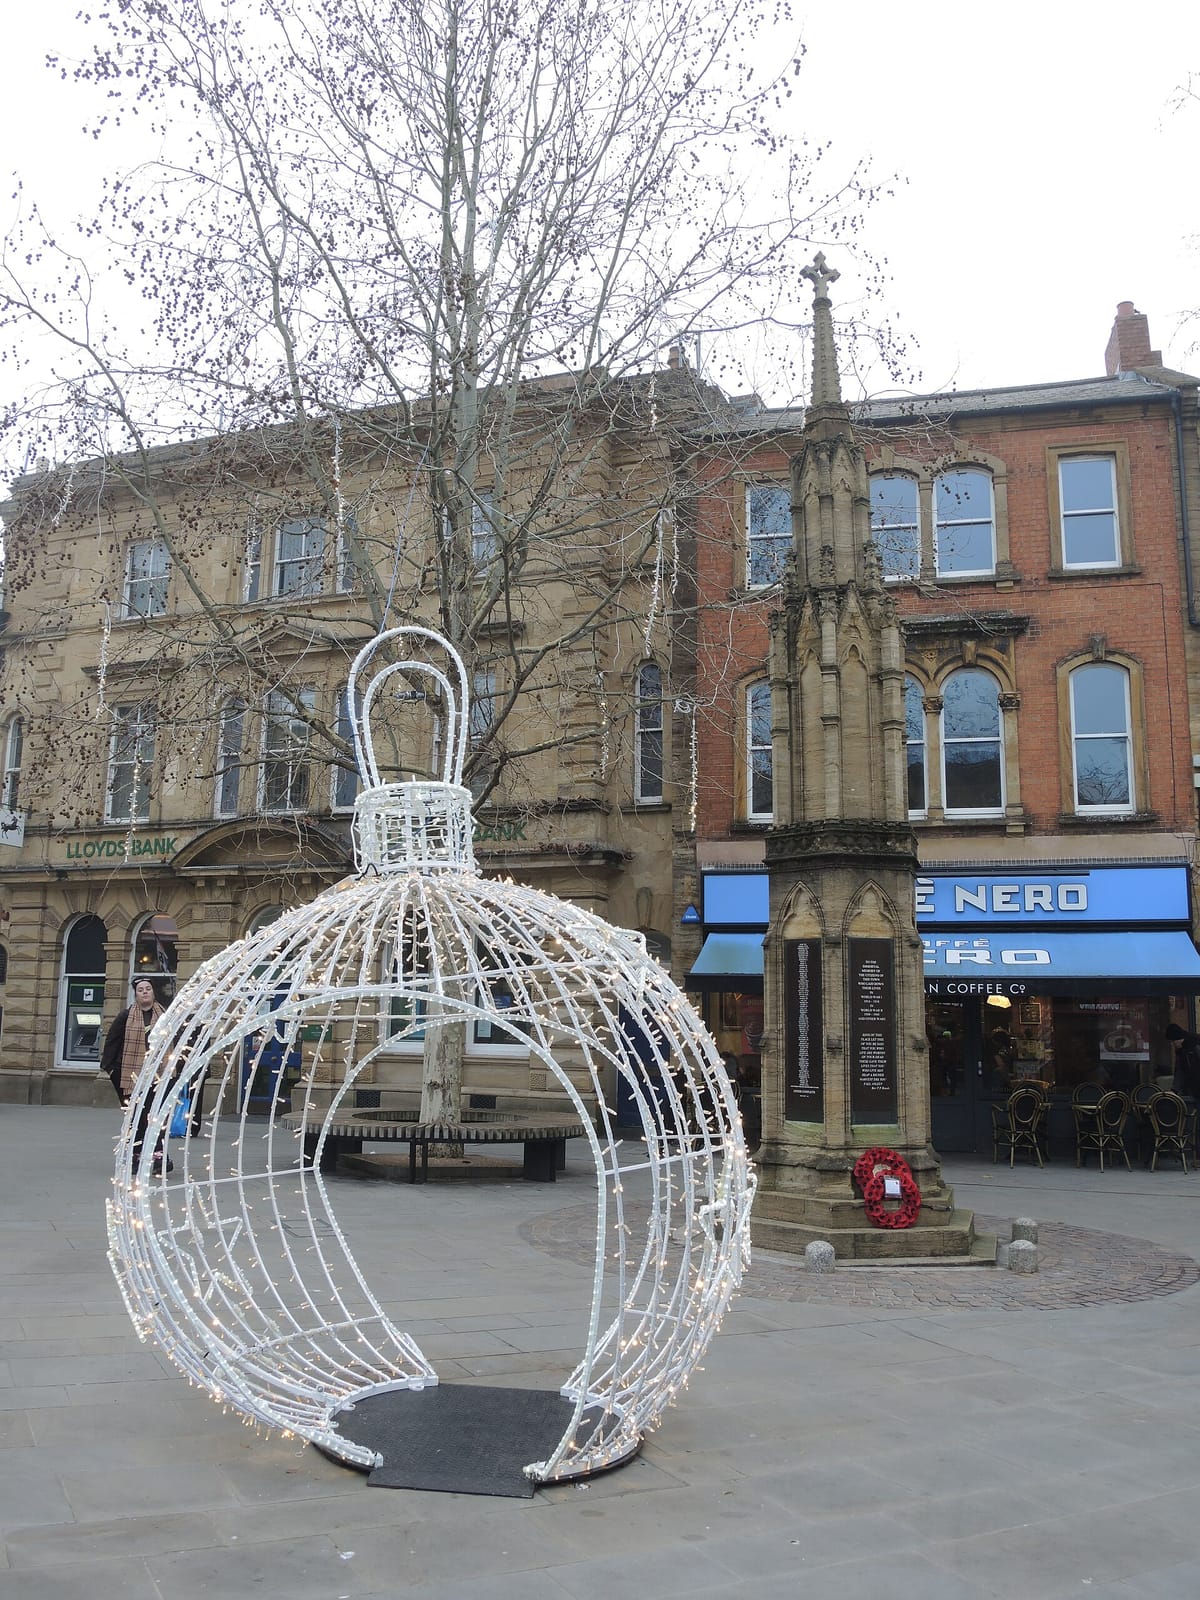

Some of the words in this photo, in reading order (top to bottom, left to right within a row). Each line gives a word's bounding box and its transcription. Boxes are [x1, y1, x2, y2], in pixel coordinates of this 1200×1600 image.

[66, 840, 126, 859] LLOYDS
[131, 837, 178, 856] BANK
[955, 884, 1088, 912] NERO
[947, 983, 1002, 994] COFFEE
